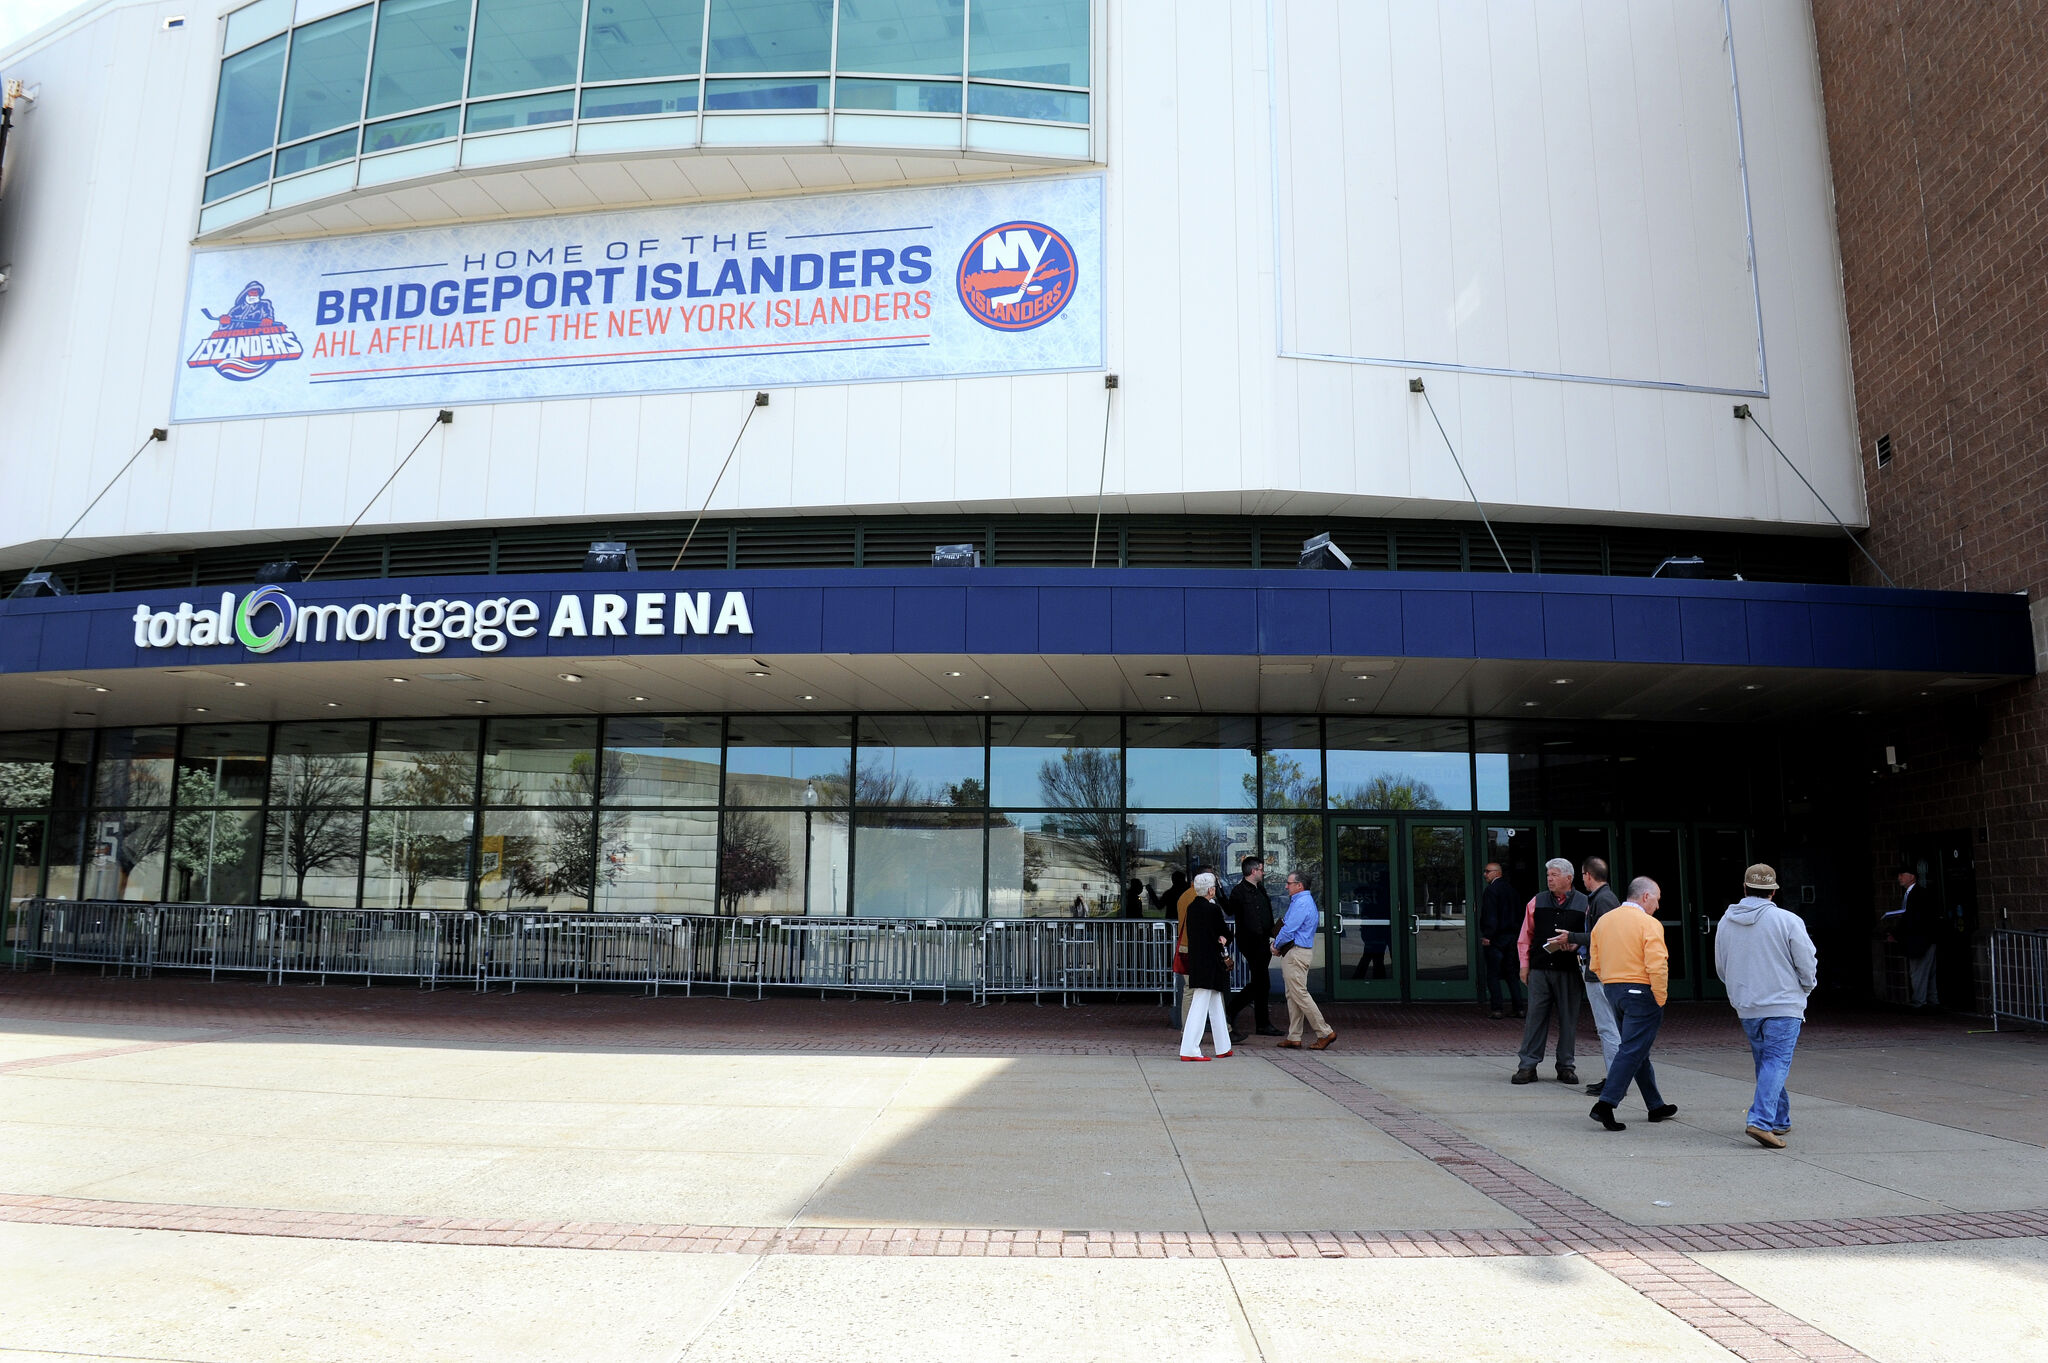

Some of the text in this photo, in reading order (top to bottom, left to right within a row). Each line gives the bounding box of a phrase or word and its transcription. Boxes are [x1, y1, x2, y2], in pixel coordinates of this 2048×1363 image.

[463, 230, 768, 272] HOME OF THE
[982, 229, 1052, 275] NY
[315, 245, 933, 326] BRIDGEPORT ISLANDERS
[970, 280, 1062, 322] ISLANDERS
[210, 325, 288, 339] BRIDGEPORT
[312, 289, 932, 358] AHL AFFILIATE OF THE NEW YORK ISLANDERS
[187, 331, 303, 365] ISLANDERS
[132, 591, 754, 654] total mortgage ARENA
